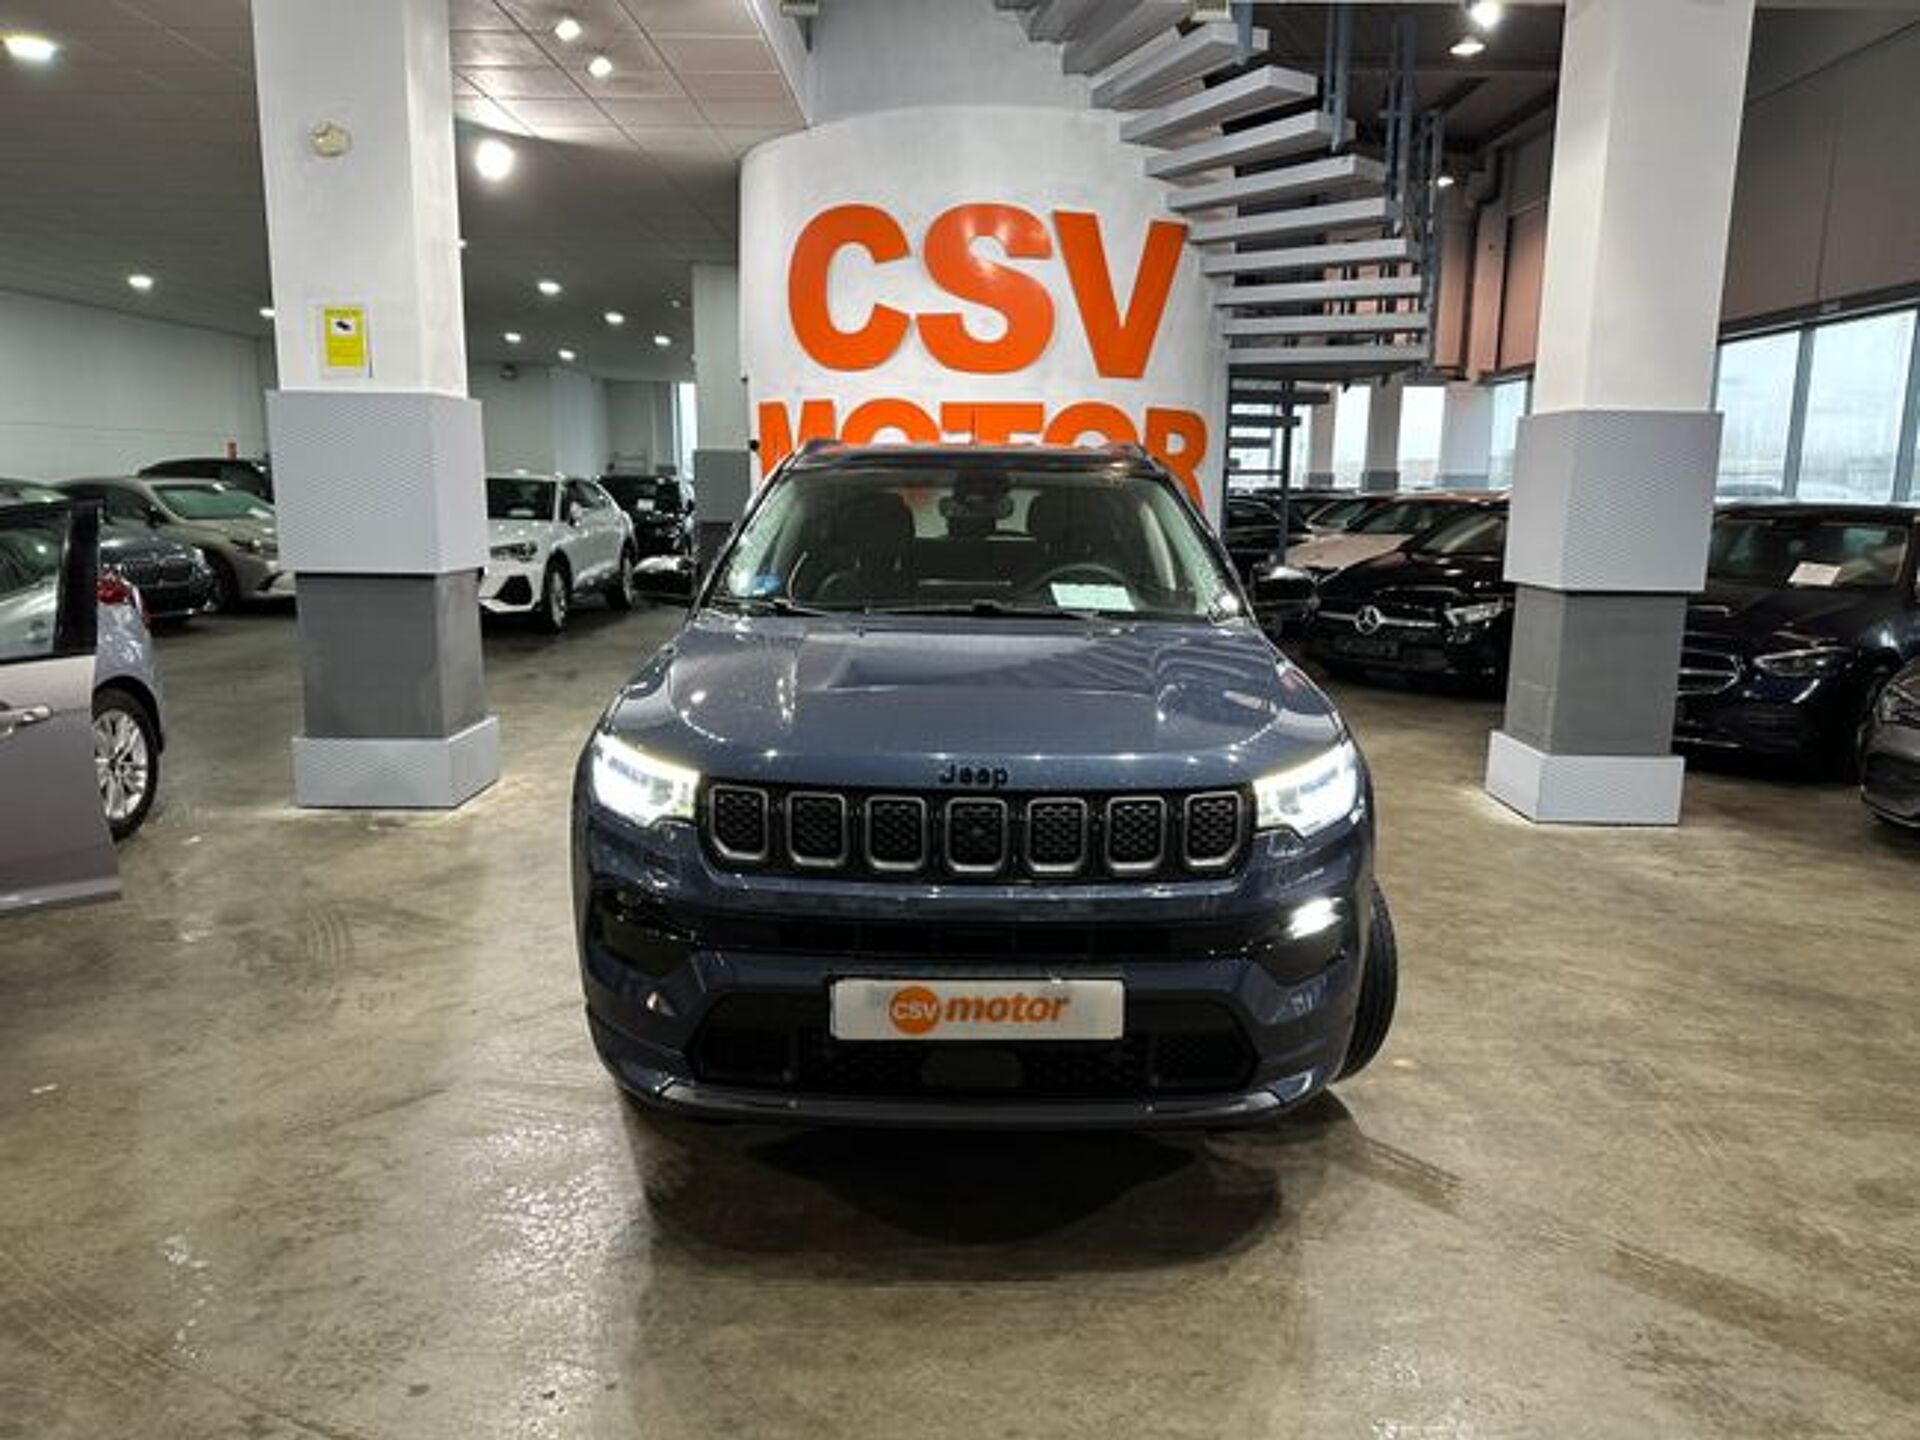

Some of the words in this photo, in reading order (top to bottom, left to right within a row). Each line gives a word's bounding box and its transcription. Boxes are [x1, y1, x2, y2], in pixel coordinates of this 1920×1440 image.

[787, 203, 1188, 379] CSV
[939, 764, 1008, 788] Jeep
[945, 994, 1070, 1022] motor
